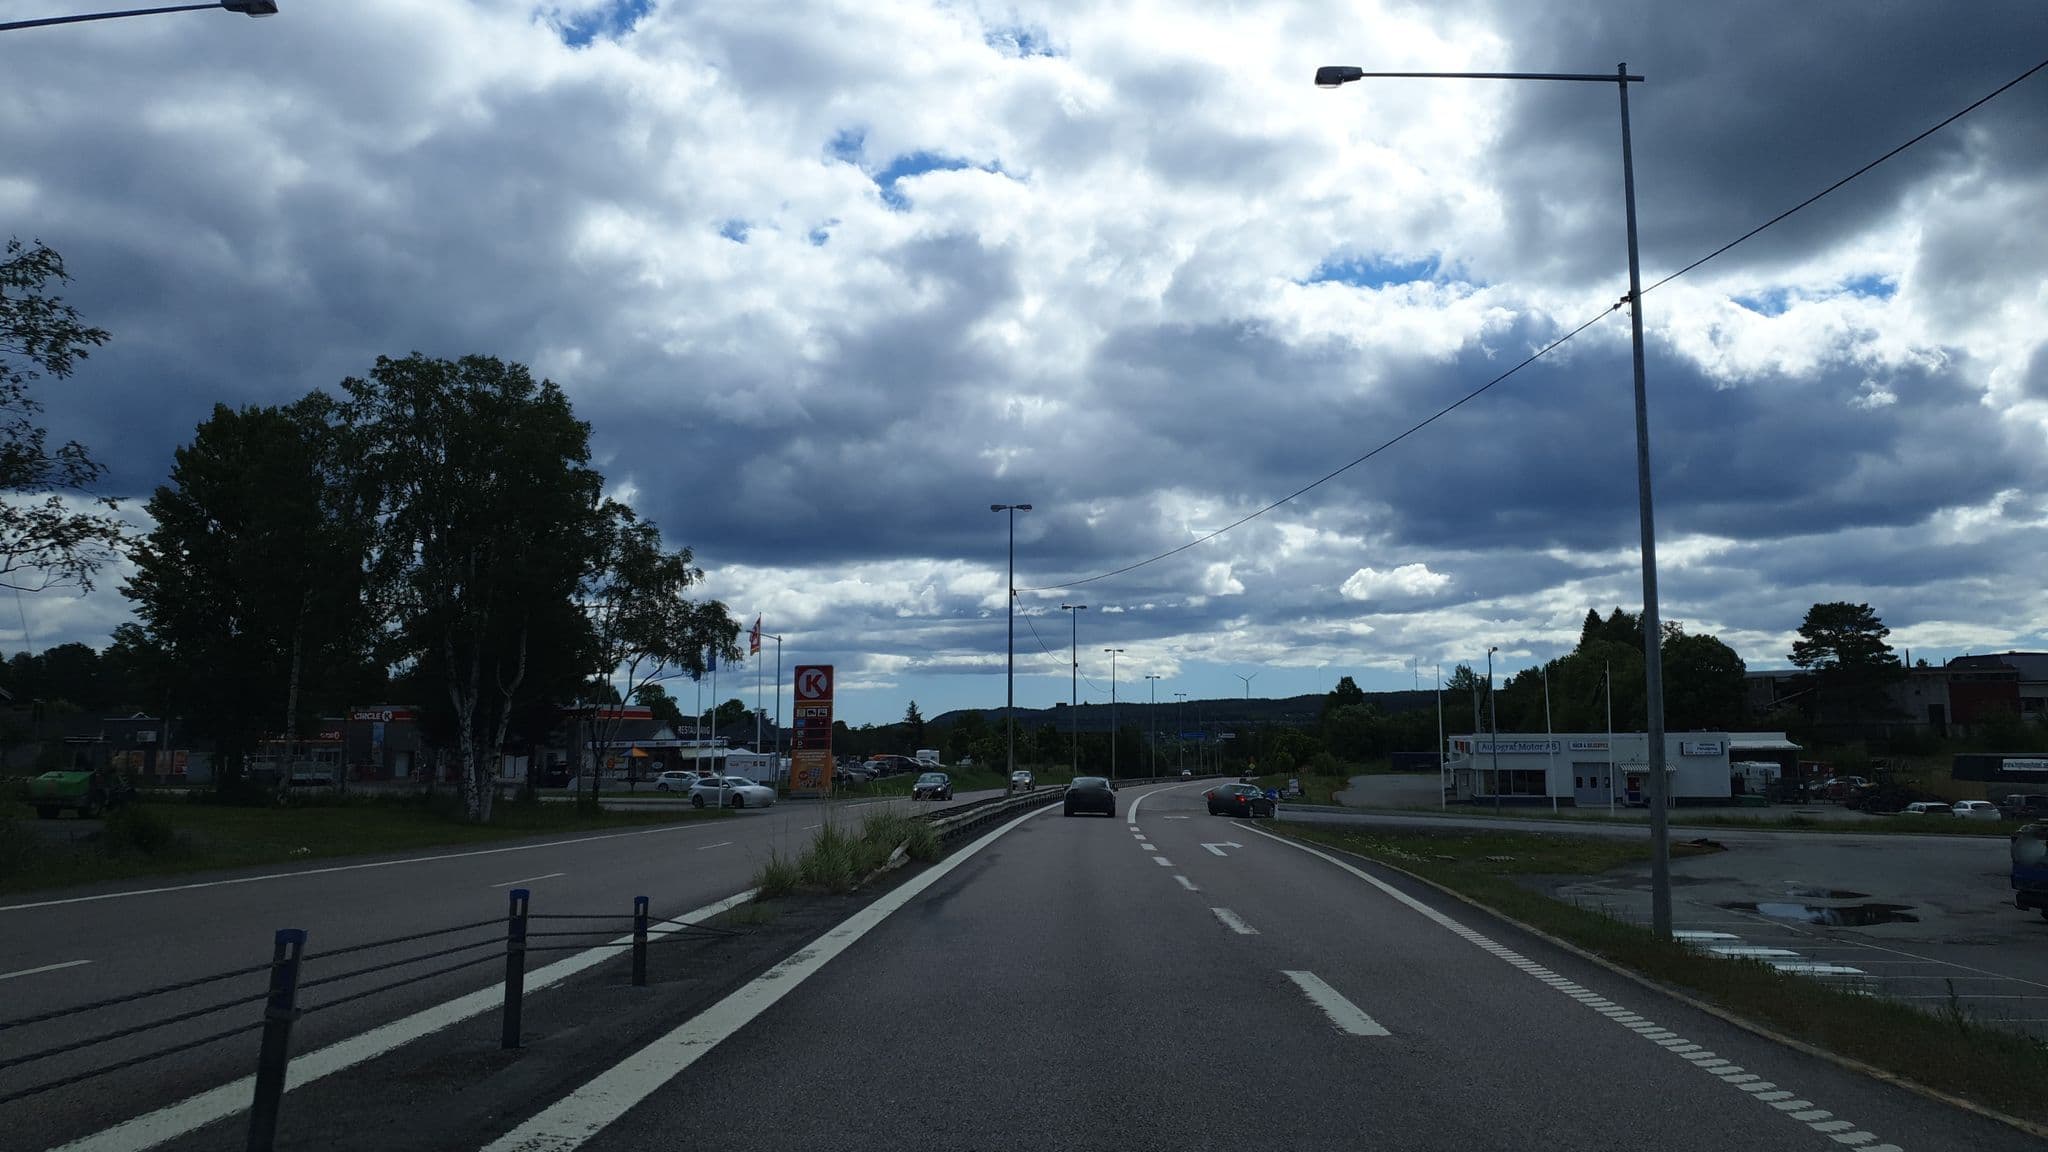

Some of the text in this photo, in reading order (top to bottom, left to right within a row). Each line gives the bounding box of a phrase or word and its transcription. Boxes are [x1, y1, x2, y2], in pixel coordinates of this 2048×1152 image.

[382, 711, 392, 722] K
[1481, 742, 1518, 752] Auograf
[1519, 743, 1543, 751] Motor
